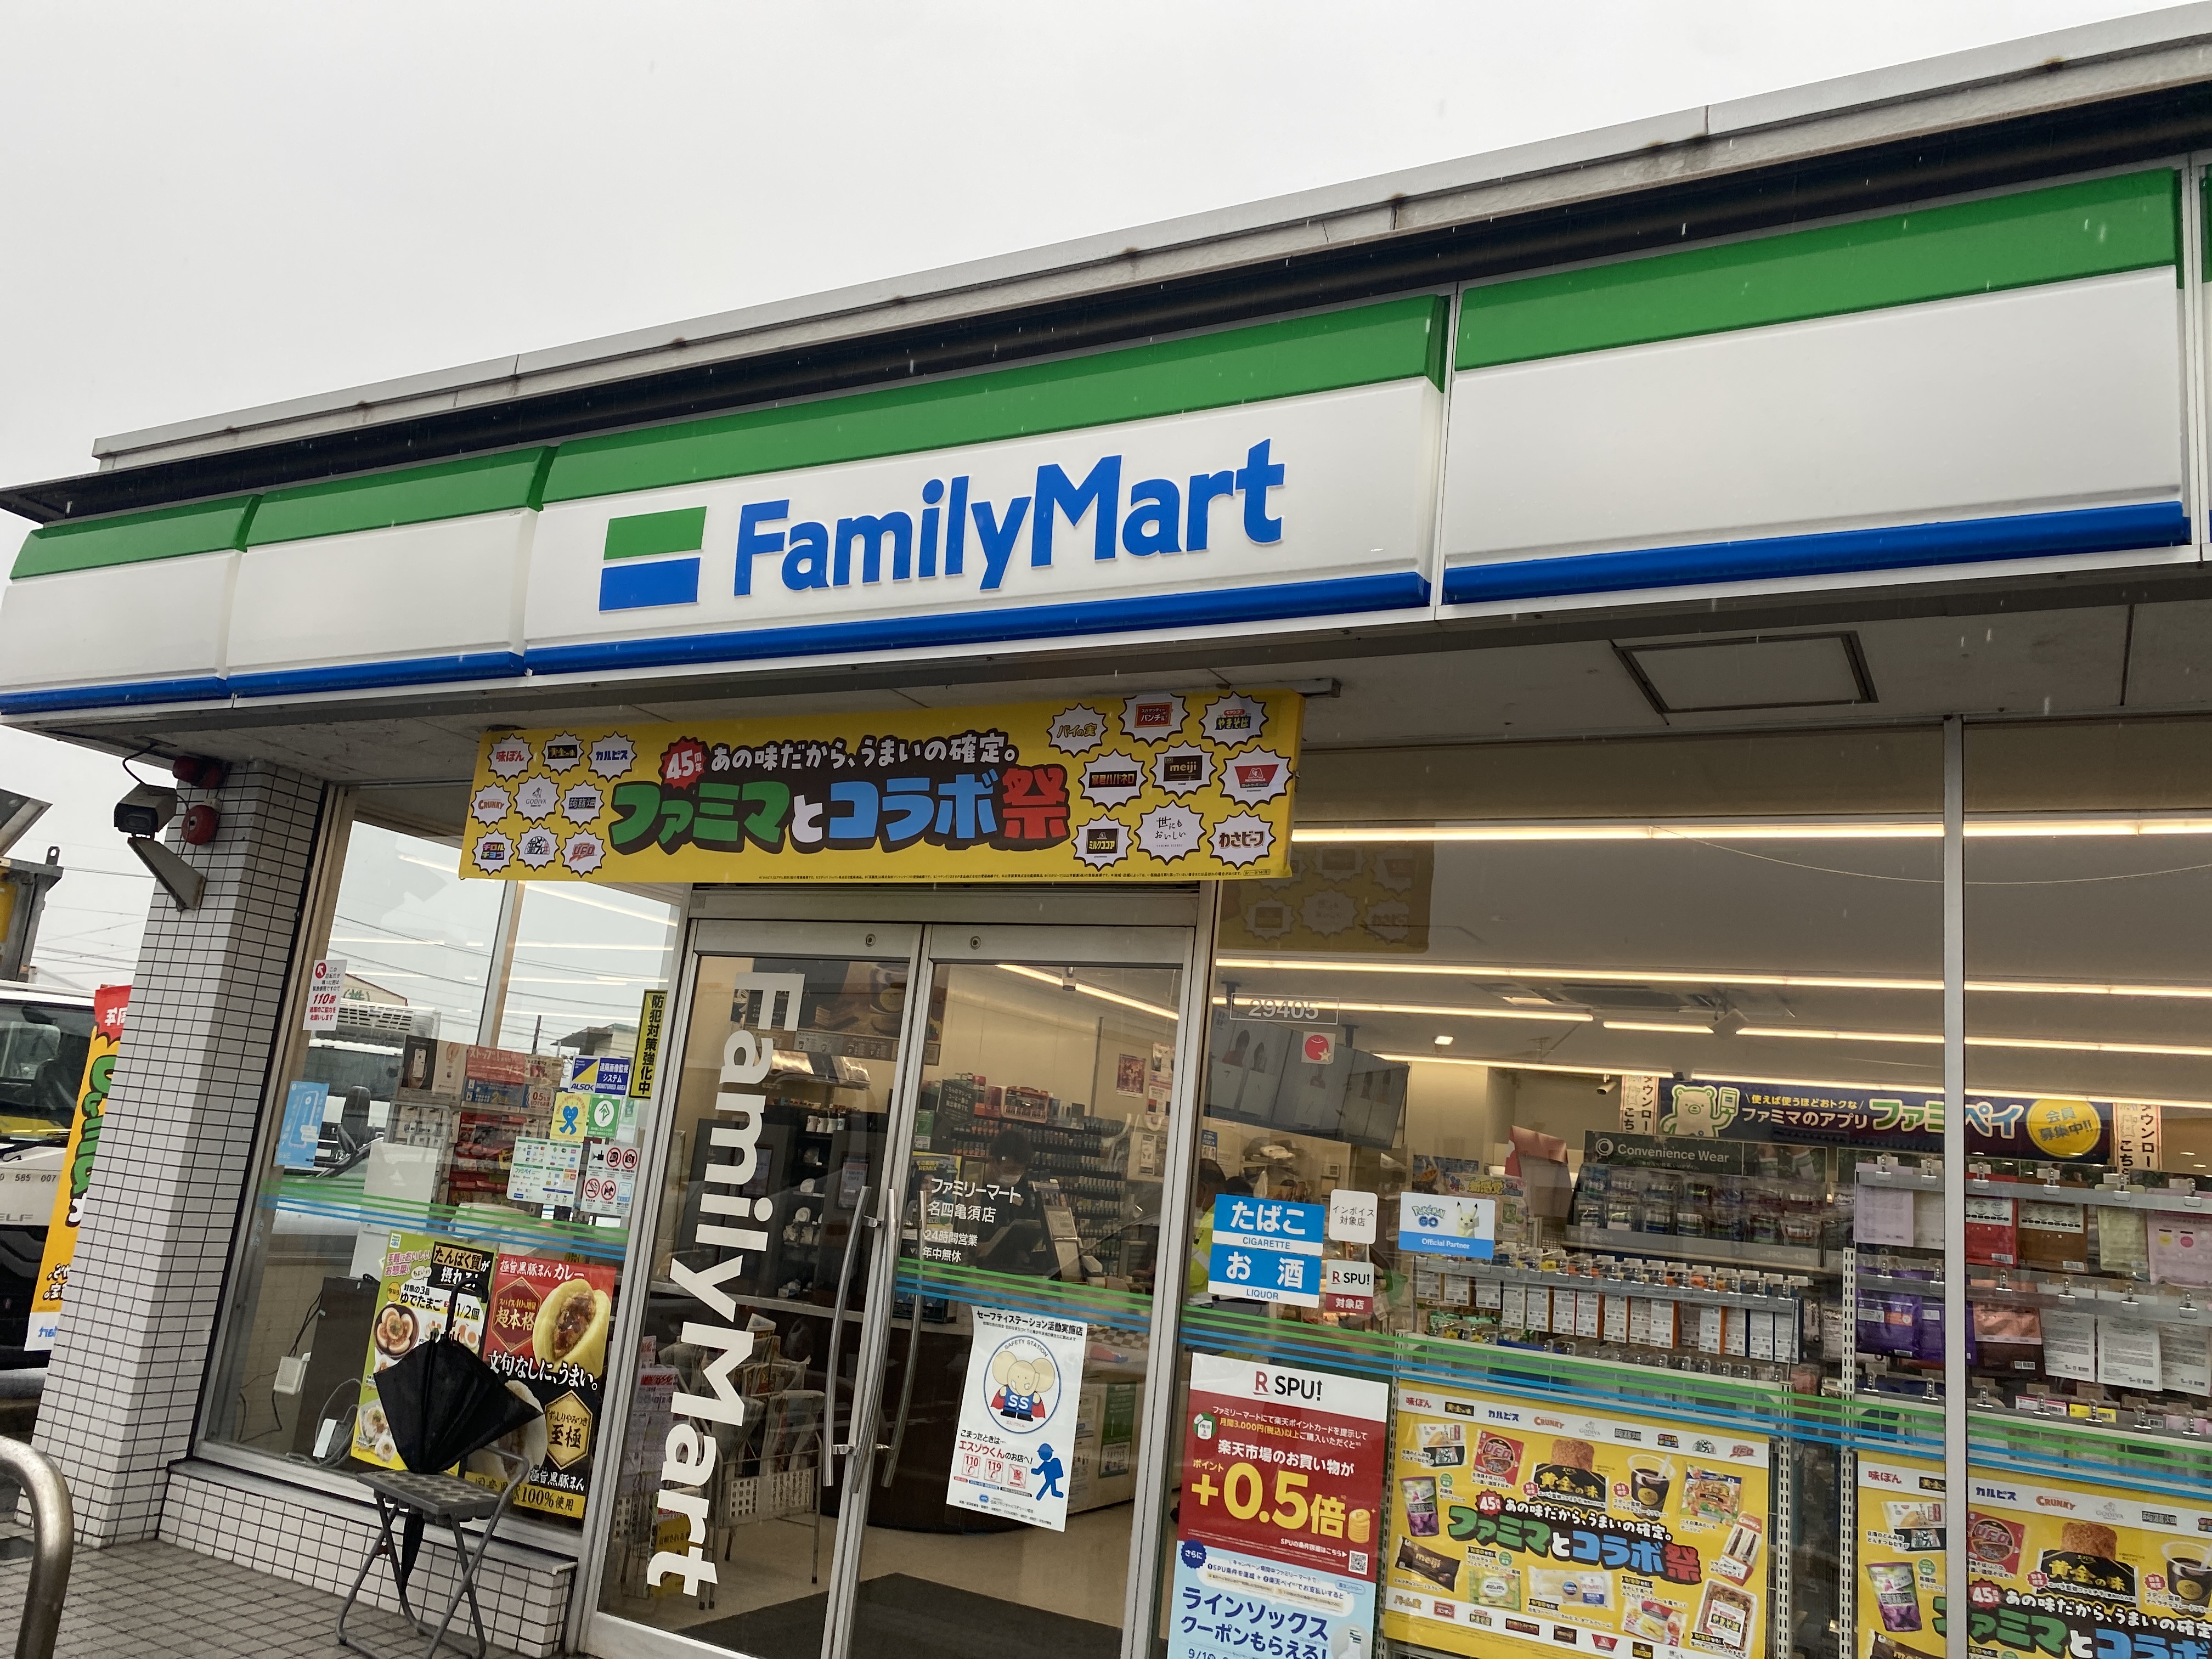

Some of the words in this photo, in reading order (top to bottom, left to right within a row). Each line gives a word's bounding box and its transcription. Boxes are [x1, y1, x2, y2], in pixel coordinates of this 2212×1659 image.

[734, 438, 1285, 597] FamilyMart
[1057, 723, 1097, 737] パイの実
[1216, 718, 1250, 729] やきそば
[496, 750, 524, 762] 味ぽん
[596, 750, 628, 761] カルピス
[711, 736, 1015, 772] あの味だから、うまいの確定。
[1170, 761, 1197, 772] meiji
[478, 799, 505, 810] CRUNKY
[611, 768, 1067, 845] ファミマとコラボ祭
[1156, 817, 1182, 829] 世にも
[1154, 831, 1186, 840] おいしい
[1219, 831, 1265, 848] わさビーフ
[313, 994, 336, 1004] 110番
[1248, 1000, 1319, 1019] 29405
[638, 995, 664, 1095] 防犯対策強化中
[600, 1063, 629, 1073] 遠隔画像監視
[603, 1074, 622, 1083] システム
[571, 1083, 594, 1091] ALSOK
[1751, 1095, 1858, 1110] 使えば使うほどおトクな
[1742, 1107, 1867, 1129] ファミマのアプリ
[2045, 1107, 2076, 1123] 会員
[2039, 1120, 2094, 1142] 募集中!!
[1618, 1144, 1696, 1160] Convenience
[1698, 1151, 1730, 1163] Wear
[930, 1178, 1021, 1204] ファミリーマート
[928, 1200, 996, 1223] 名四亀須店
[1231, 1201, 1306, 1235] たばこ
[1333, 1205, 1374, 1217] インボイス
[1339, 1216, 1365, 1227] 対象店
[1418, 1216, 1439, 1228] GO
[924, 1229, 978, 1246] 24時間営業
[1242, 1237, 1291, 1249] CIGARETTE
[1421, 1238, 1445, 1247] Official
[1446, 1240, 1470, 1250] Partner
[387, 1250, 431, 1264] 手軽においしい
[433, 1247, 491, 1272] たんぱく質が
[922, 1246, 962, 1262] 年中無休
[647, 972, 805, 1597] FamilyMart
[1331, 1271, 1340, 1284] R
[400, 1293, 443, 1311] ゆでたまご
[1246, 1289, 1279, 1300] LIQUOR
[1335, 1298, 1364, 1310] 対象店
[457, 1303, 480, 1321] 1/2個
[495, 1307, 535, 1330] 超本格
[977, 1311, 1083, 1336] セーフティステーション活動実施店
[1004, 1339, 1025, 1350] SAFETY
[1026, 1340, 1048, 1357] STATION
[488, 1350, 597, 1390] 文句なしに、うまい。
[1252, 1370, 1270, 1396] R
[1406, 1397, 1432, 1409] 味ぽん
[1212, 1406, 1368, 1440] ファミリーマートにて楽天ポイントカードを提示して
[1488, 1409, 1520, 1422] カルピス
[1534, 1416, 1565, 1429] CRUNKY
[549, 1424, 582, 1449] 至極
[1579, 1428, 1601, 1436] GODIVA
[966, 1455, 978, 1466] 110
[1193, 1459, 1224, 1472] ポイント
[1217, 1439, 1355, 1477] 楽天市場のお買い物が
[988, 1461, 1001, 1471] 119
[529, 1469, 584, 1491] 極旨黒豚まん
[1540, 1471, 1599, 1498] 黄金の味
[1868, 1471, 1903, 1485] 味ぽん
[1191, 1462, 1346, 1539] +0.5倍
[1976, 1487, 2017, 1502] カルピス
[2036, 1496, 2076, 1510] CRUNKY
[1505, 1498, 1672, 1541] あの味だから、うまいの確定。
[2096, 1510, 2124, 1520] GODIVA
[1448, 1506, 1701, 1582] ファミマとコラボ祭
[1184, 1549, 1203, 1560] さらに
[1415, 1553, 1441, 1568] meiji
[2049, 1560, 2128, 1592] 黄金の味
[1183, 1587, 1328, 1641] ラインソックス
